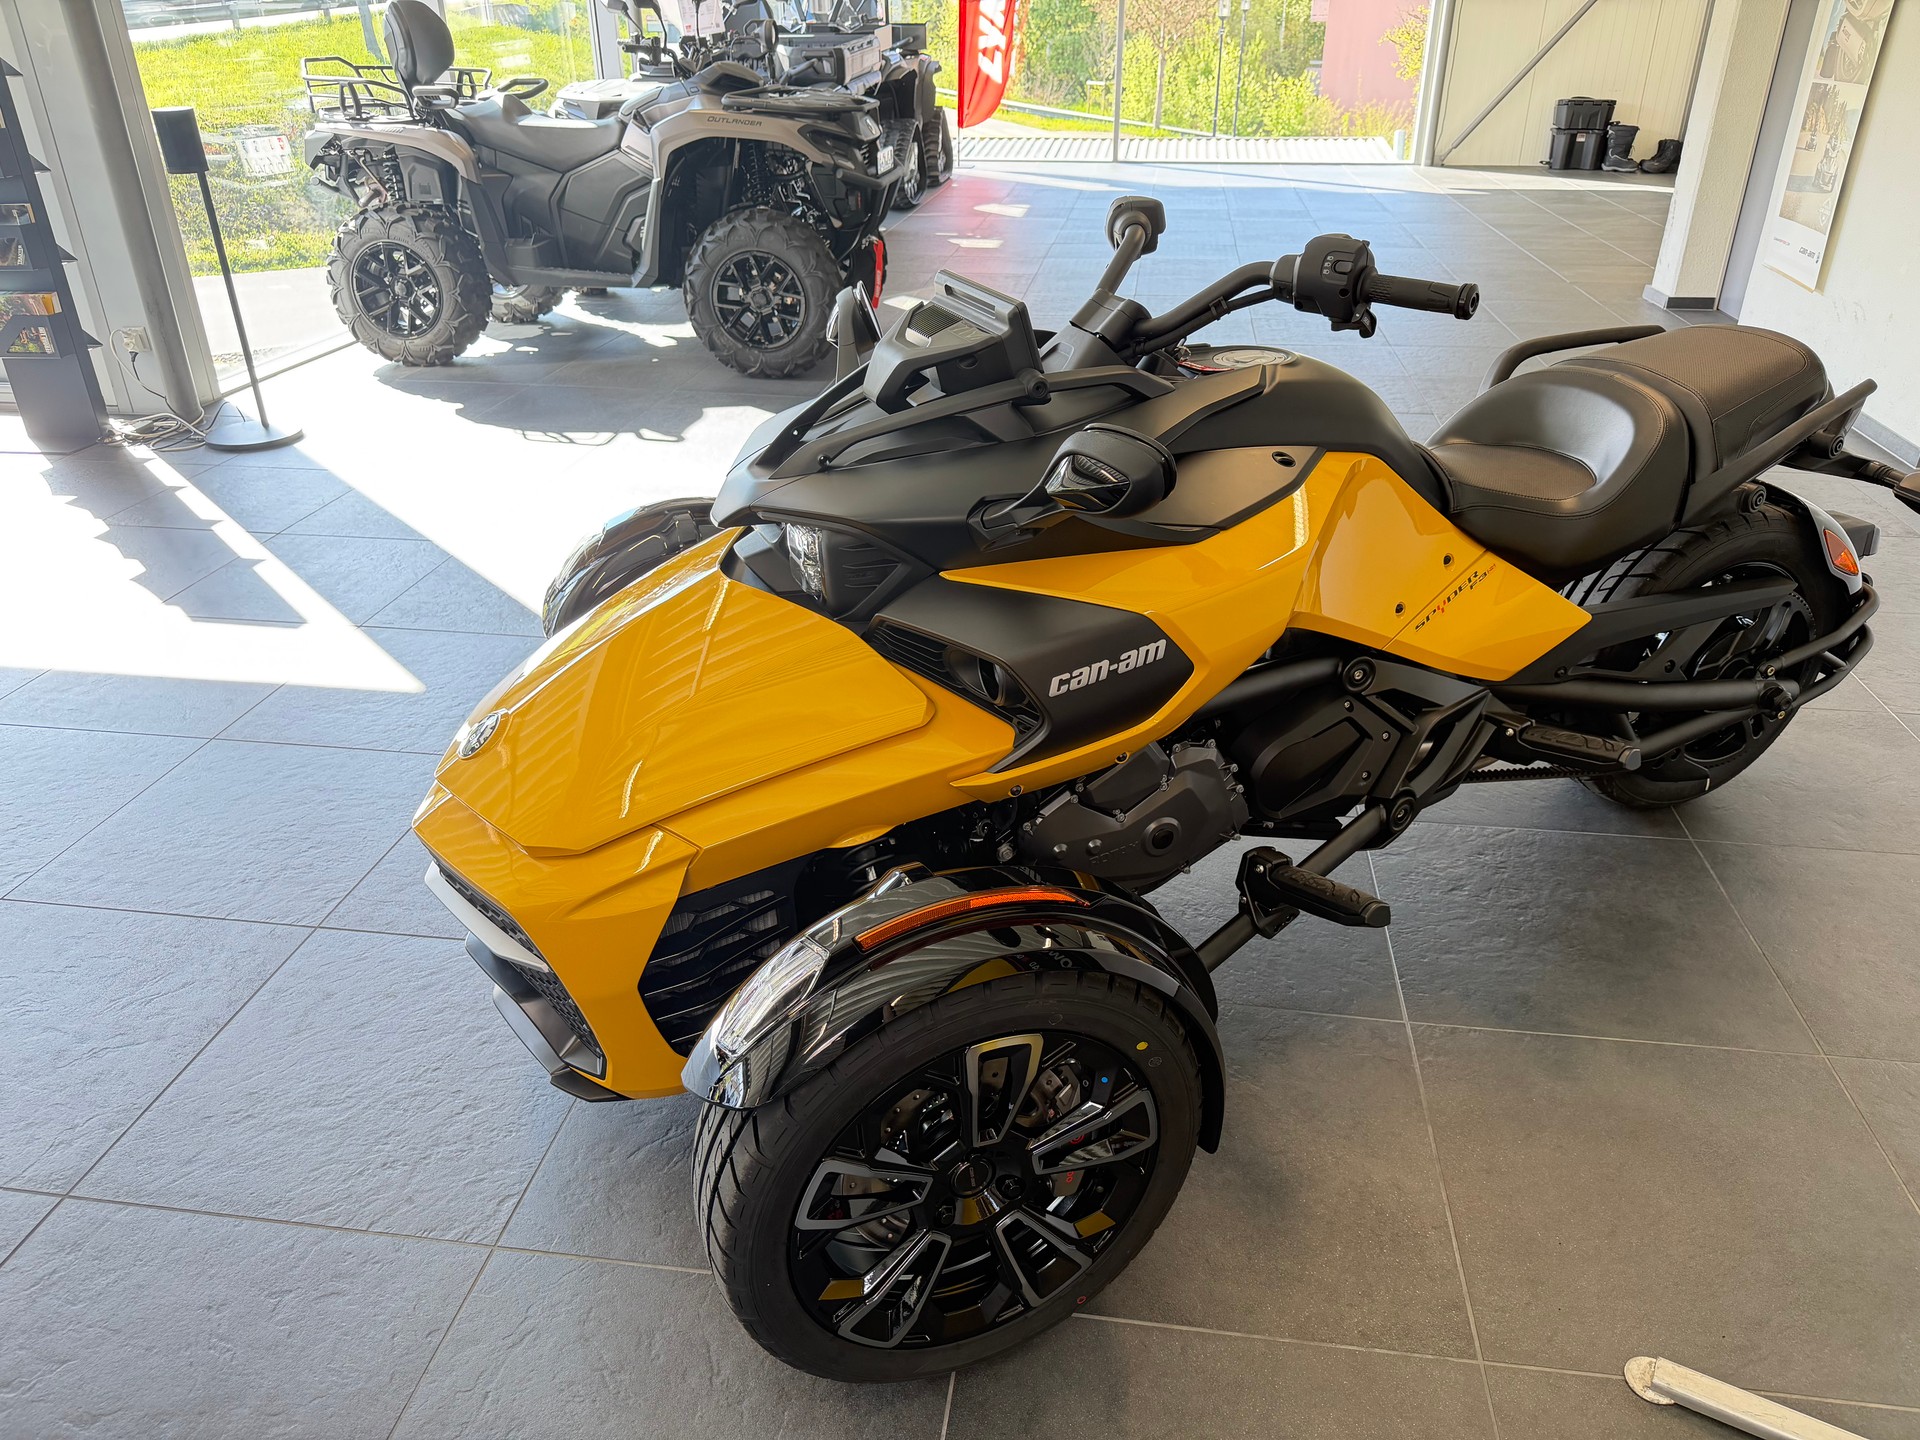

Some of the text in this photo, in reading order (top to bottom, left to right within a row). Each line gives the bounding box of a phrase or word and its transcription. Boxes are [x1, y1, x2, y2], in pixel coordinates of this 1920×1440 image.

[707, 115, 762, 127] OUTLANDER
[1415, 571, 1479, 632] SPYDER
[1048, 638, 1167, 698] can-am
